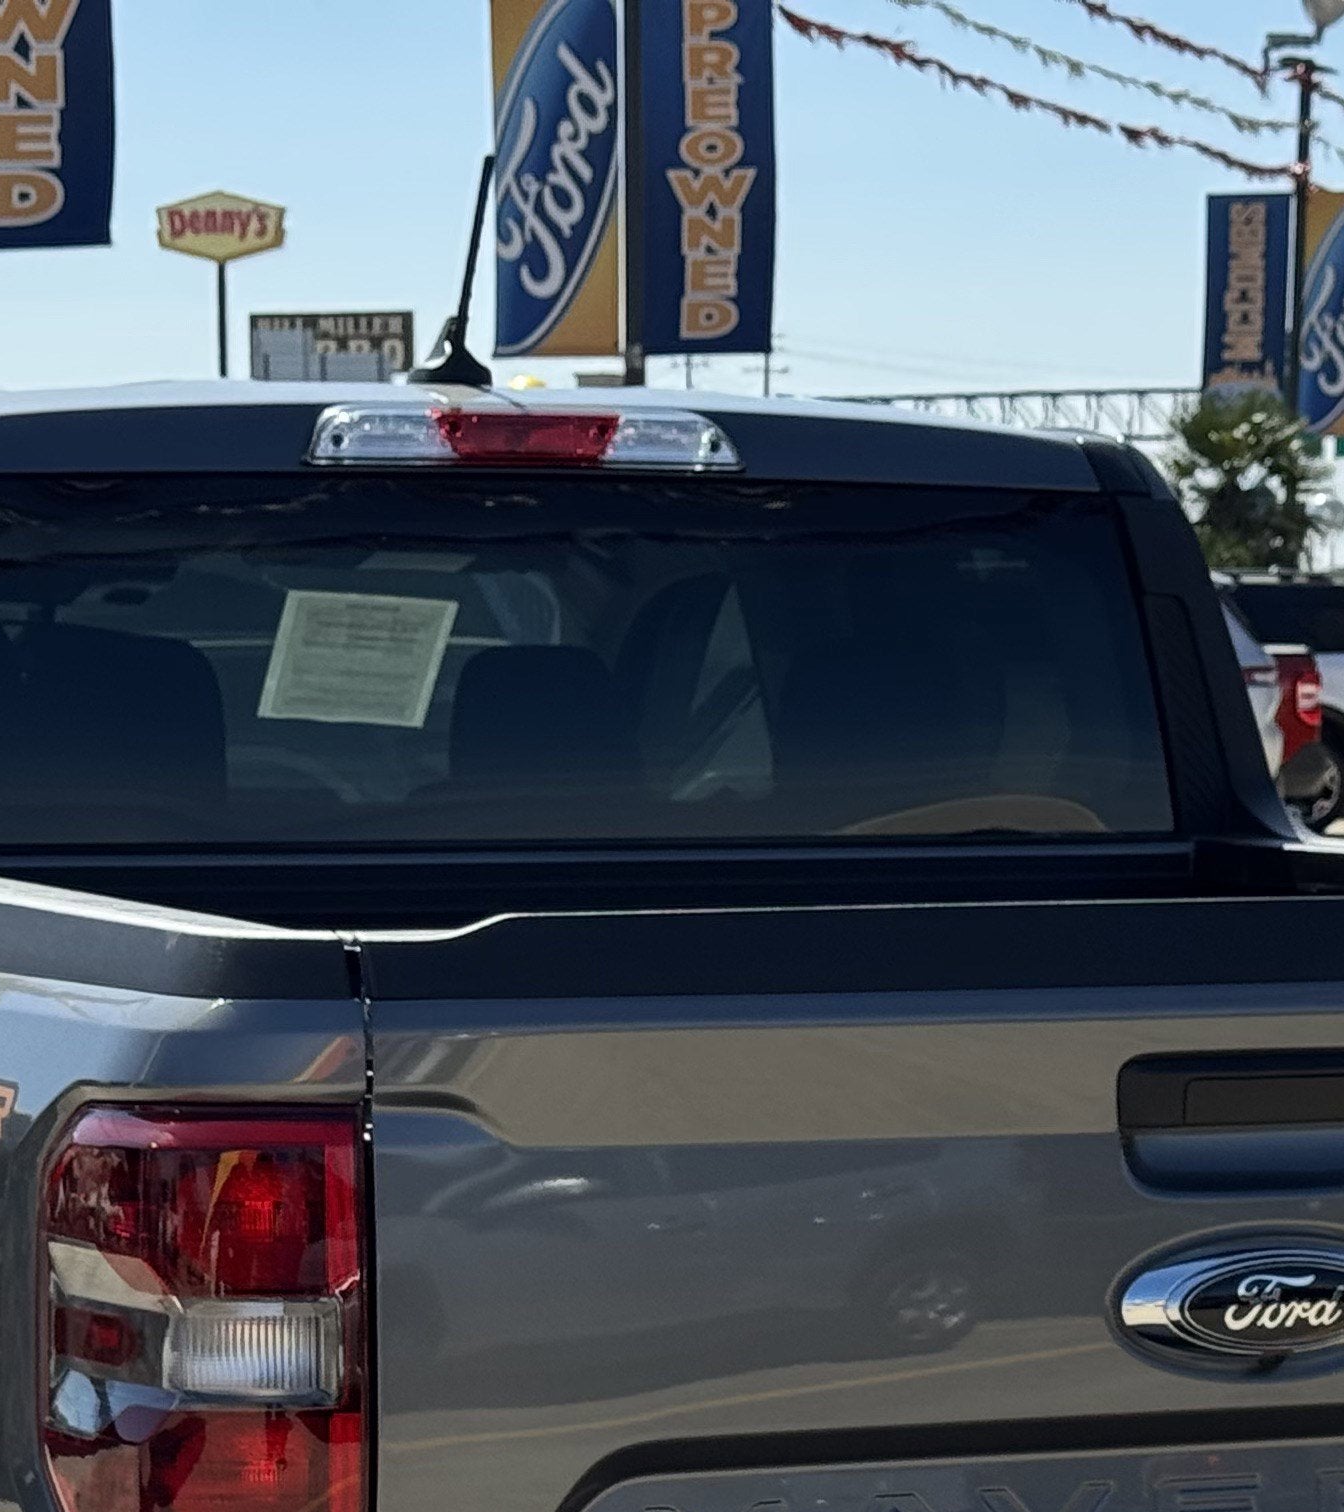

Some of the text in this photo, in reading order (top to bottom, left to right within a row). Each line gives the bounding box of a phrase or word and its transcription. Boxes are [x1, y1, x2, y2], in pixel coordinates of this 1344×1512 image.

[166, 206, 268, 241] Denny's
[497, 43, 615, 299] Ford
[665, 0, 757, 340] PREOWNED
